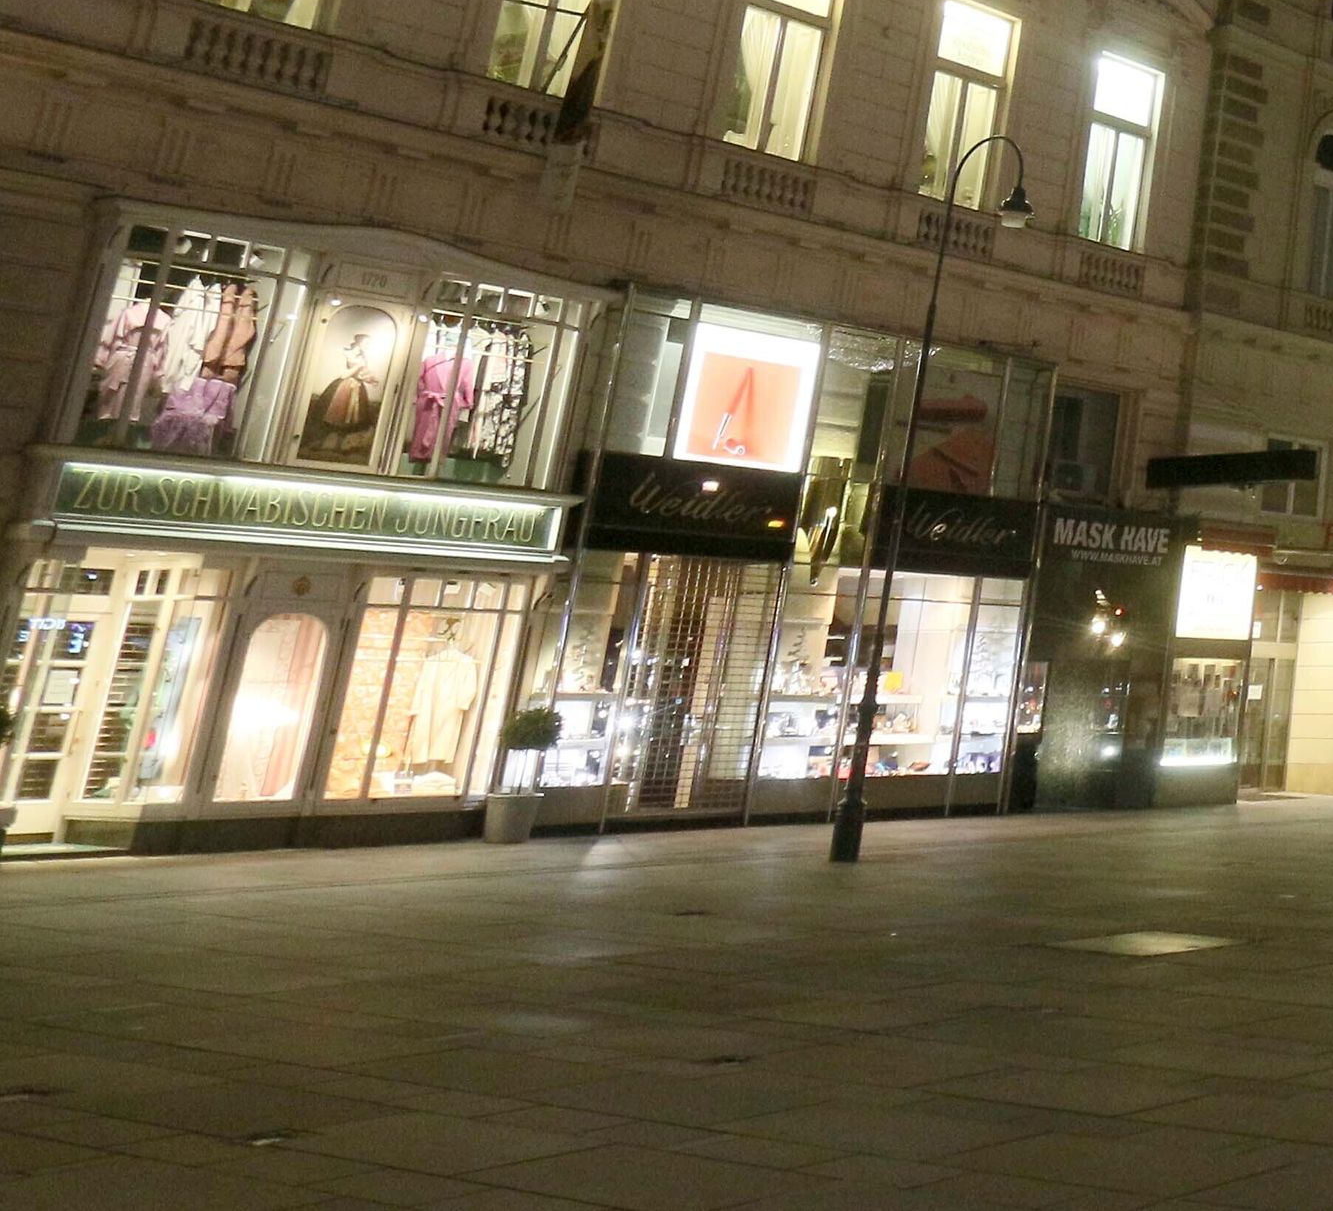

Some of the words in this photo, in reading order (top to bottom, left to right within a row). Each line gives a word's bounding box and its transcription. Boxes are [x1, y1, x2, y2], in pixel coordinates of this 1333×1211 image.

[1053, 517, 1114, 550] MASK
[1120, 526, 1170, 554] HAVE
[1071, 548, 1163, 566] WWW.MASKHAVE.AT
